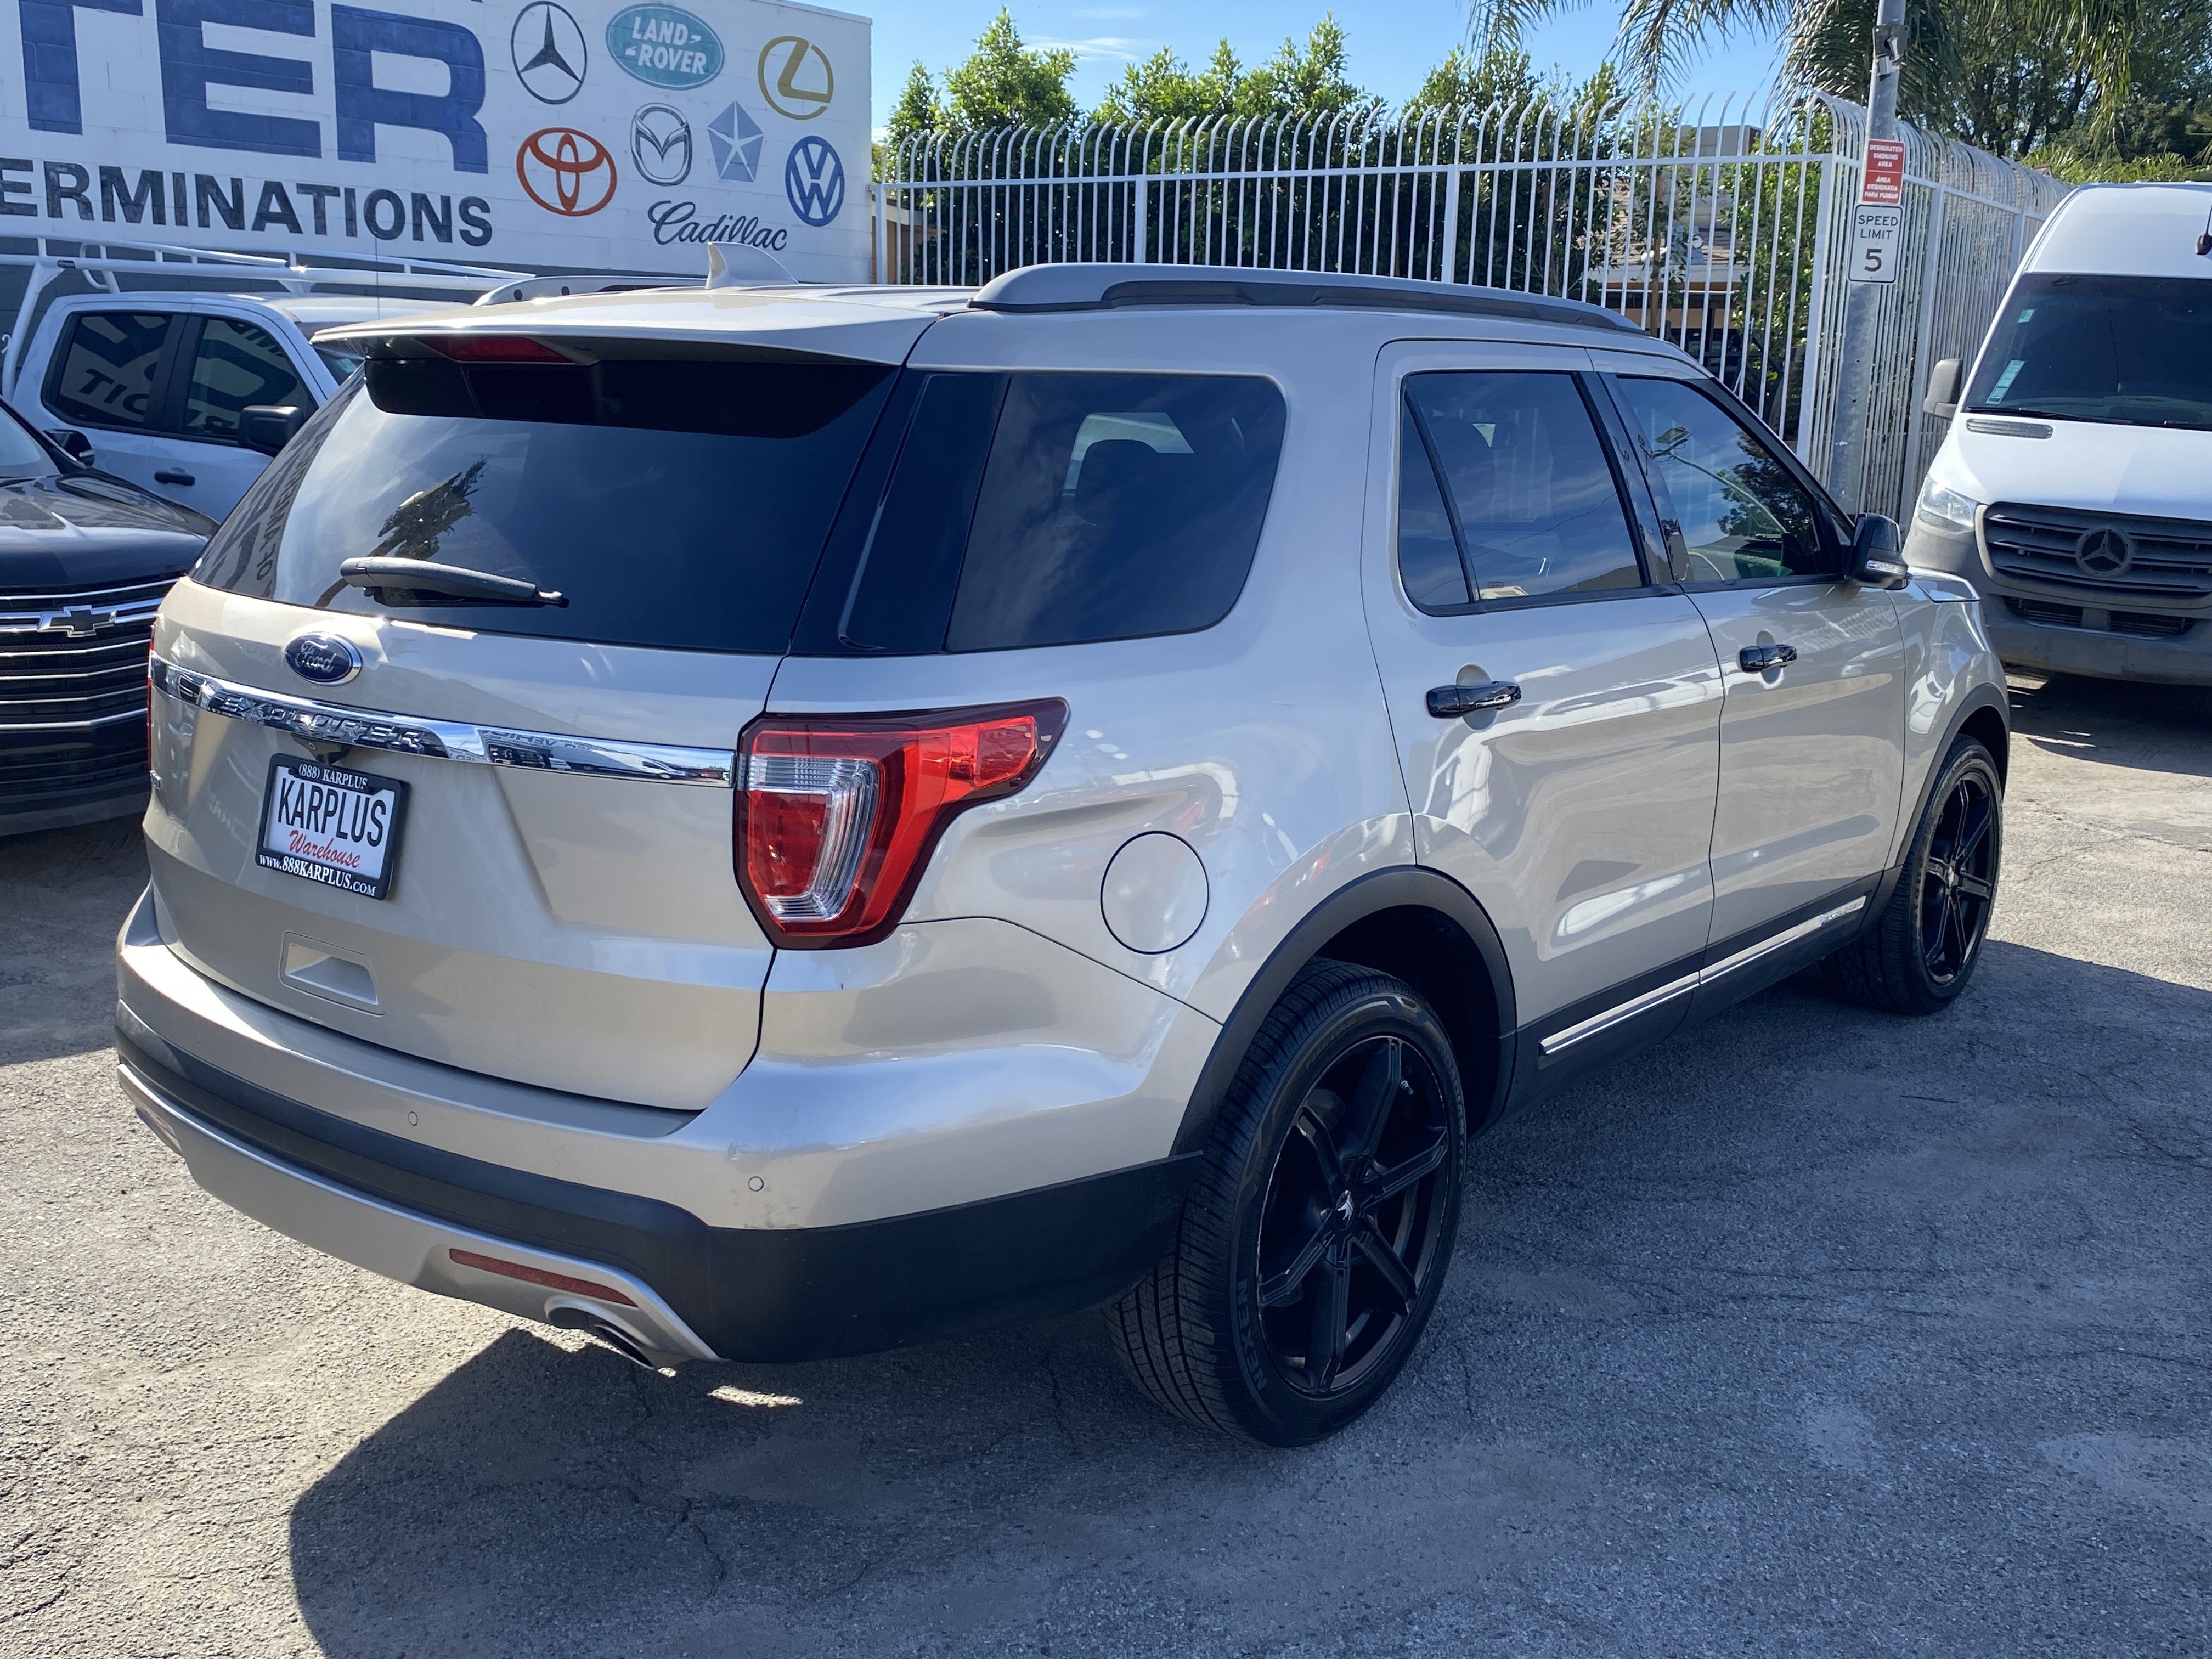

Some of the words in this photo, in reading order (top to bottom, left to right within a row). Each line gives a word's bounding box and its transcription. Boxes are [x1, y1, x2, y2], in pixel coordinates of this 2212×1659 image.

[631, 16, 689, 45] LAND
[637, 43, 707, 75] ROVER
[1870, 144, 1903, 153] DESIGNATED
[0, 157, 492, 247] ERMINATIONS
[647, 200, 788, 251] Cadillac
[1858, 215, 1898, 227] SPEED
[1860, 228, 1893, 240] LIMIT
[1864, 248, 1882, 272] 5
[295, 640, 337, 673] Ford
[222, 696, 425, 752] EXPLORER
[298, 763, 320, 780] (888)
[322, 768, 368, 790] KARPLUS
[278, 778, 387, 847] KARPLUS
[289, 830, 361, 868] Warehouse
[1237, 1278, 1267, 1390] NEXEN
